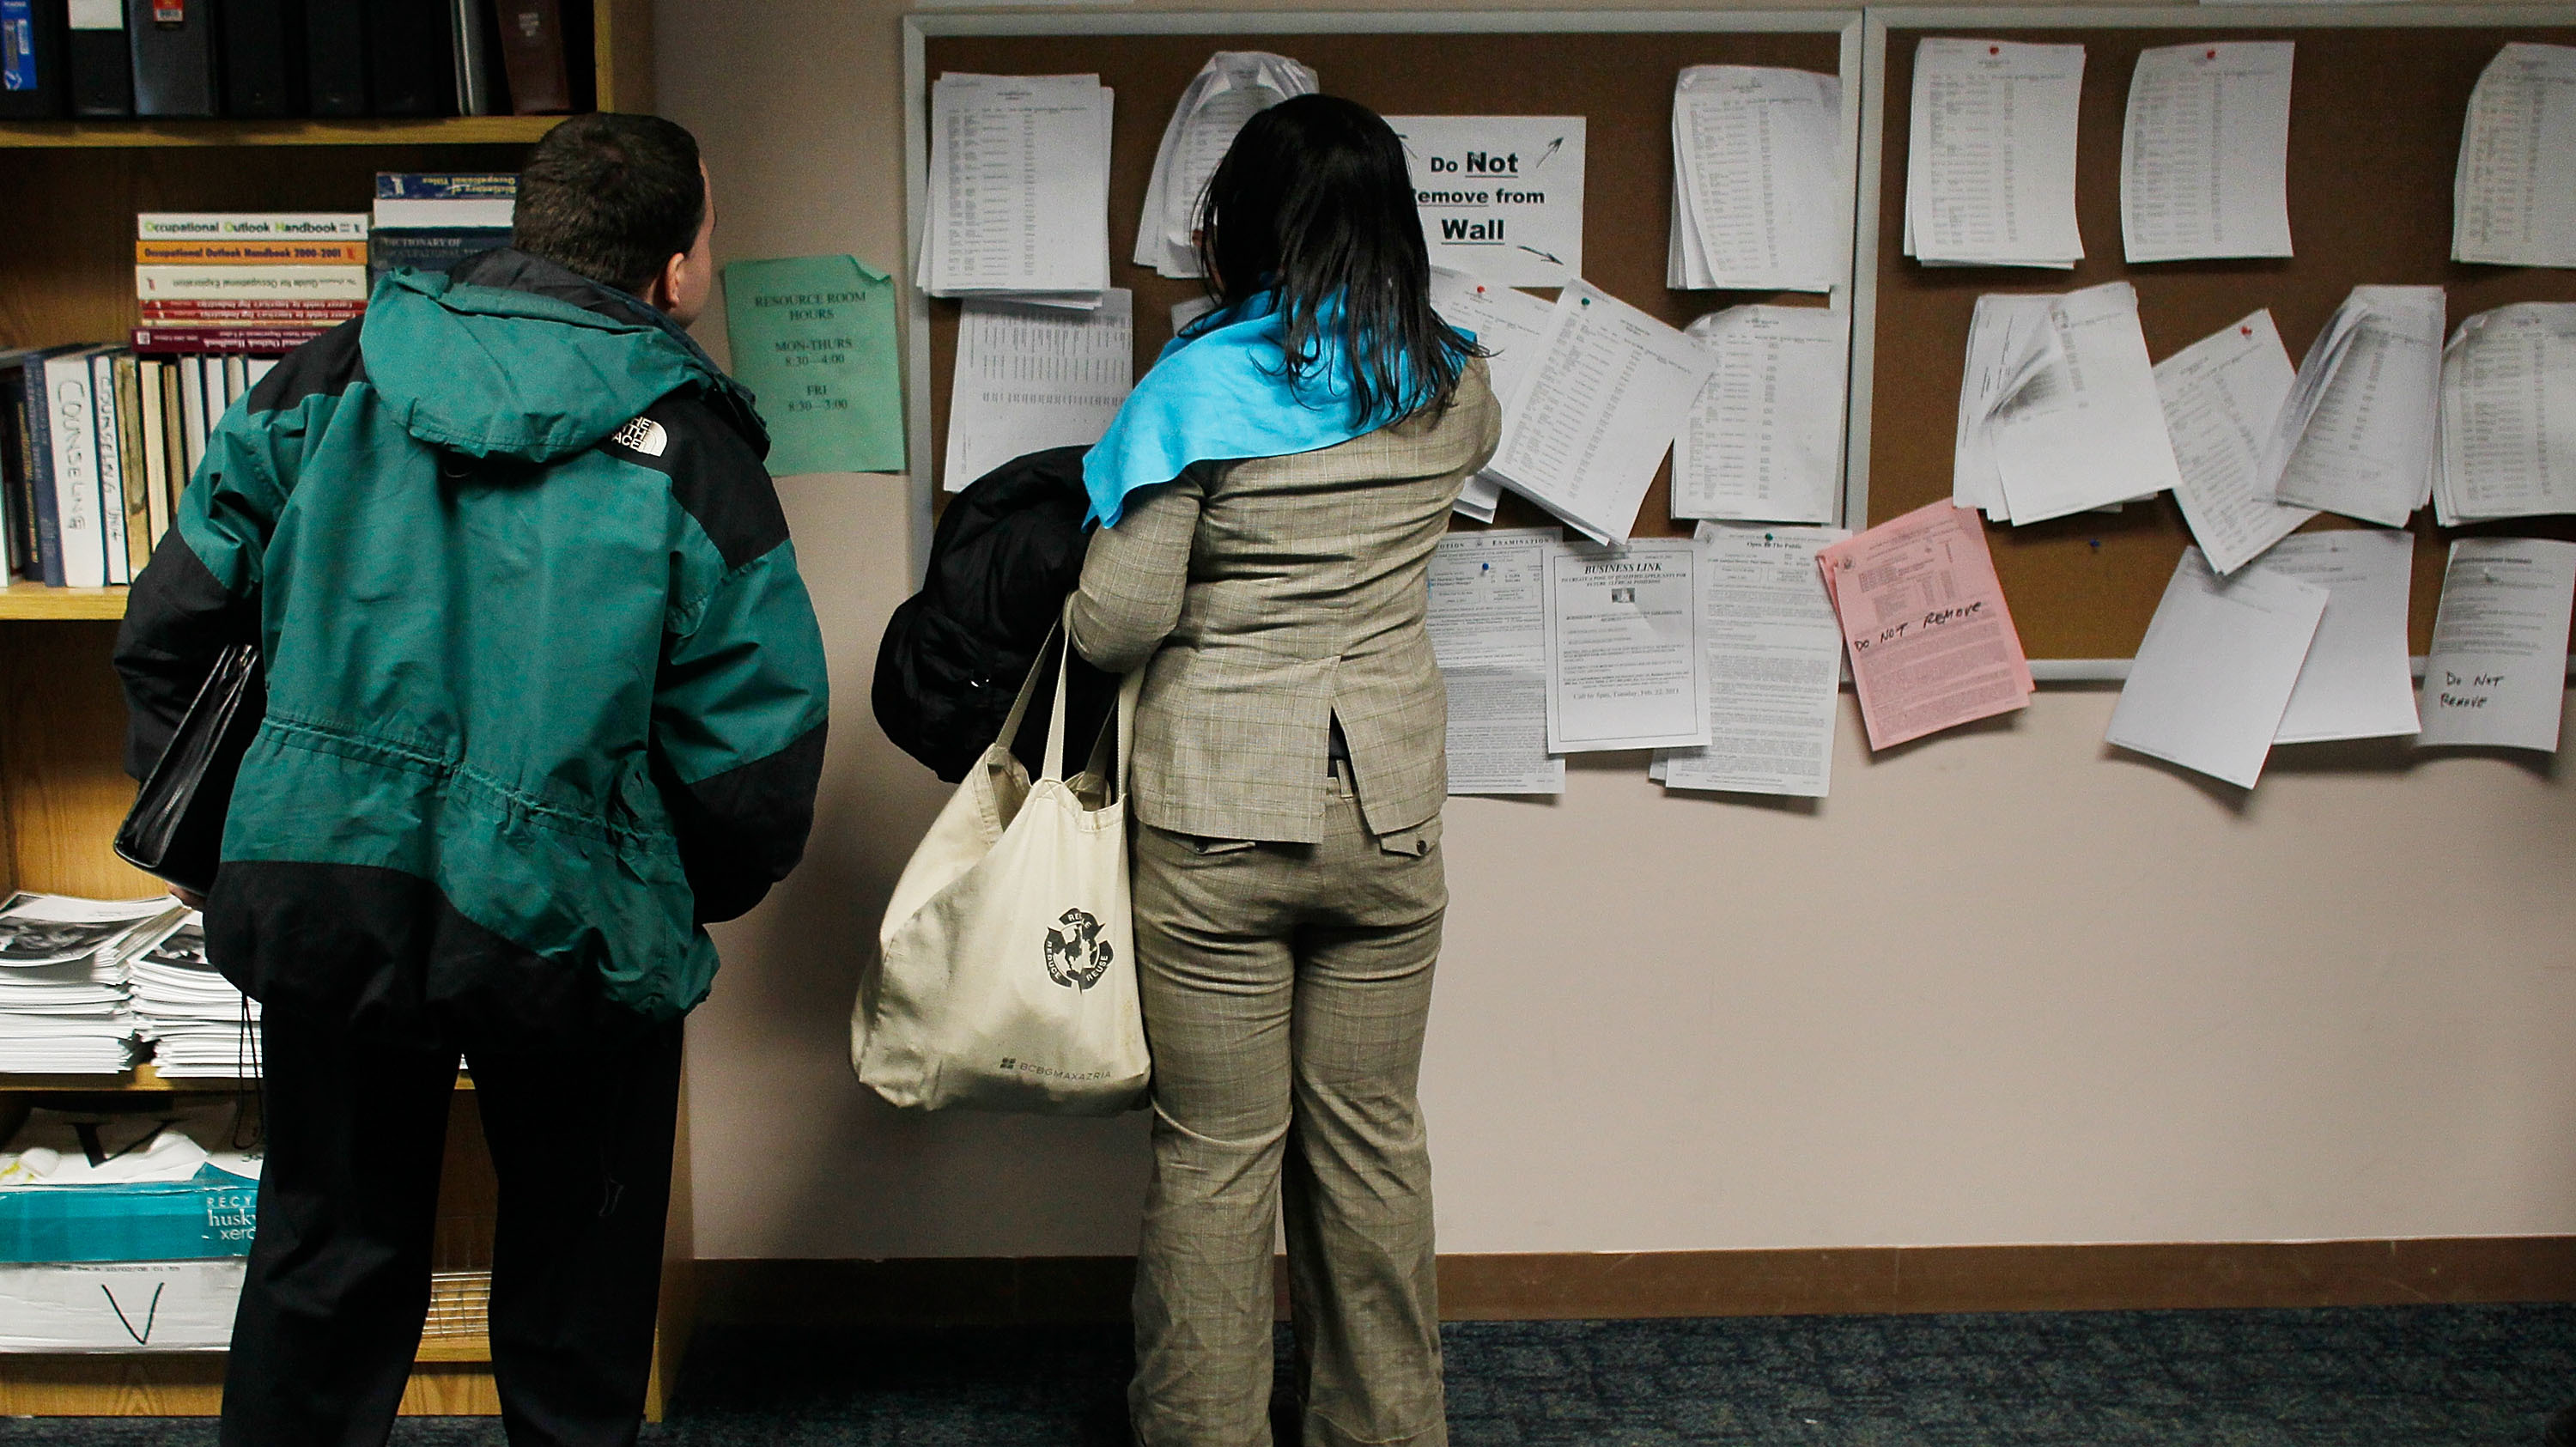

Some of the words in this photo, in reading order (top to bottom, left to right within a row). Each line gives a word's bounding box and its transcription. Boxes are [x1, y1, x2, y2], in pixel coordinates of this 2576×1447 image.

[1431, 156, 1458, 173] Do
[1467, 151, 1518, 173] Not
[1411, 188, 1489, 204] emove
[1496, 188, 1545, 204] from
[144, 222, 220, 234] Occupational
[224, 222, 270, 233] Outlook
[275, 222, 337, 233] Handbook
[1442, 219, 1504, 240] Wall
[144, 248, 203, 258] Occupational
[205, 248, 242, 258] Outlook
[244, 248, 291, 258] Handbook
[294, 279, 319, 289] Guide
[755, 294, 822, 307] RESOURCE
[826, 292, 867, 304] ROOM
[789, 309, 835, 321] HOURS
[775, 337, 853, 352] MON-THURS
[785, 356, 809, 367] 8:30
[821, 355, 845, 365] 4:00
[806, 385, 827, 396] FRI
[788, 401, 812, 412] 8:30
[611, 432, 642, 449] ACE
[1585, 563, 1634, 575] BUSINESS
[1637, 562, 1662, 572] LINK
[1880, 622, 1909, 643] NOT
[1046, 940, 1062, 980] REDUCE
[1085, 955, 1109, 982] REUSE
[1019, 1062, 1111, 1080] BCBGMAXAZRIA
